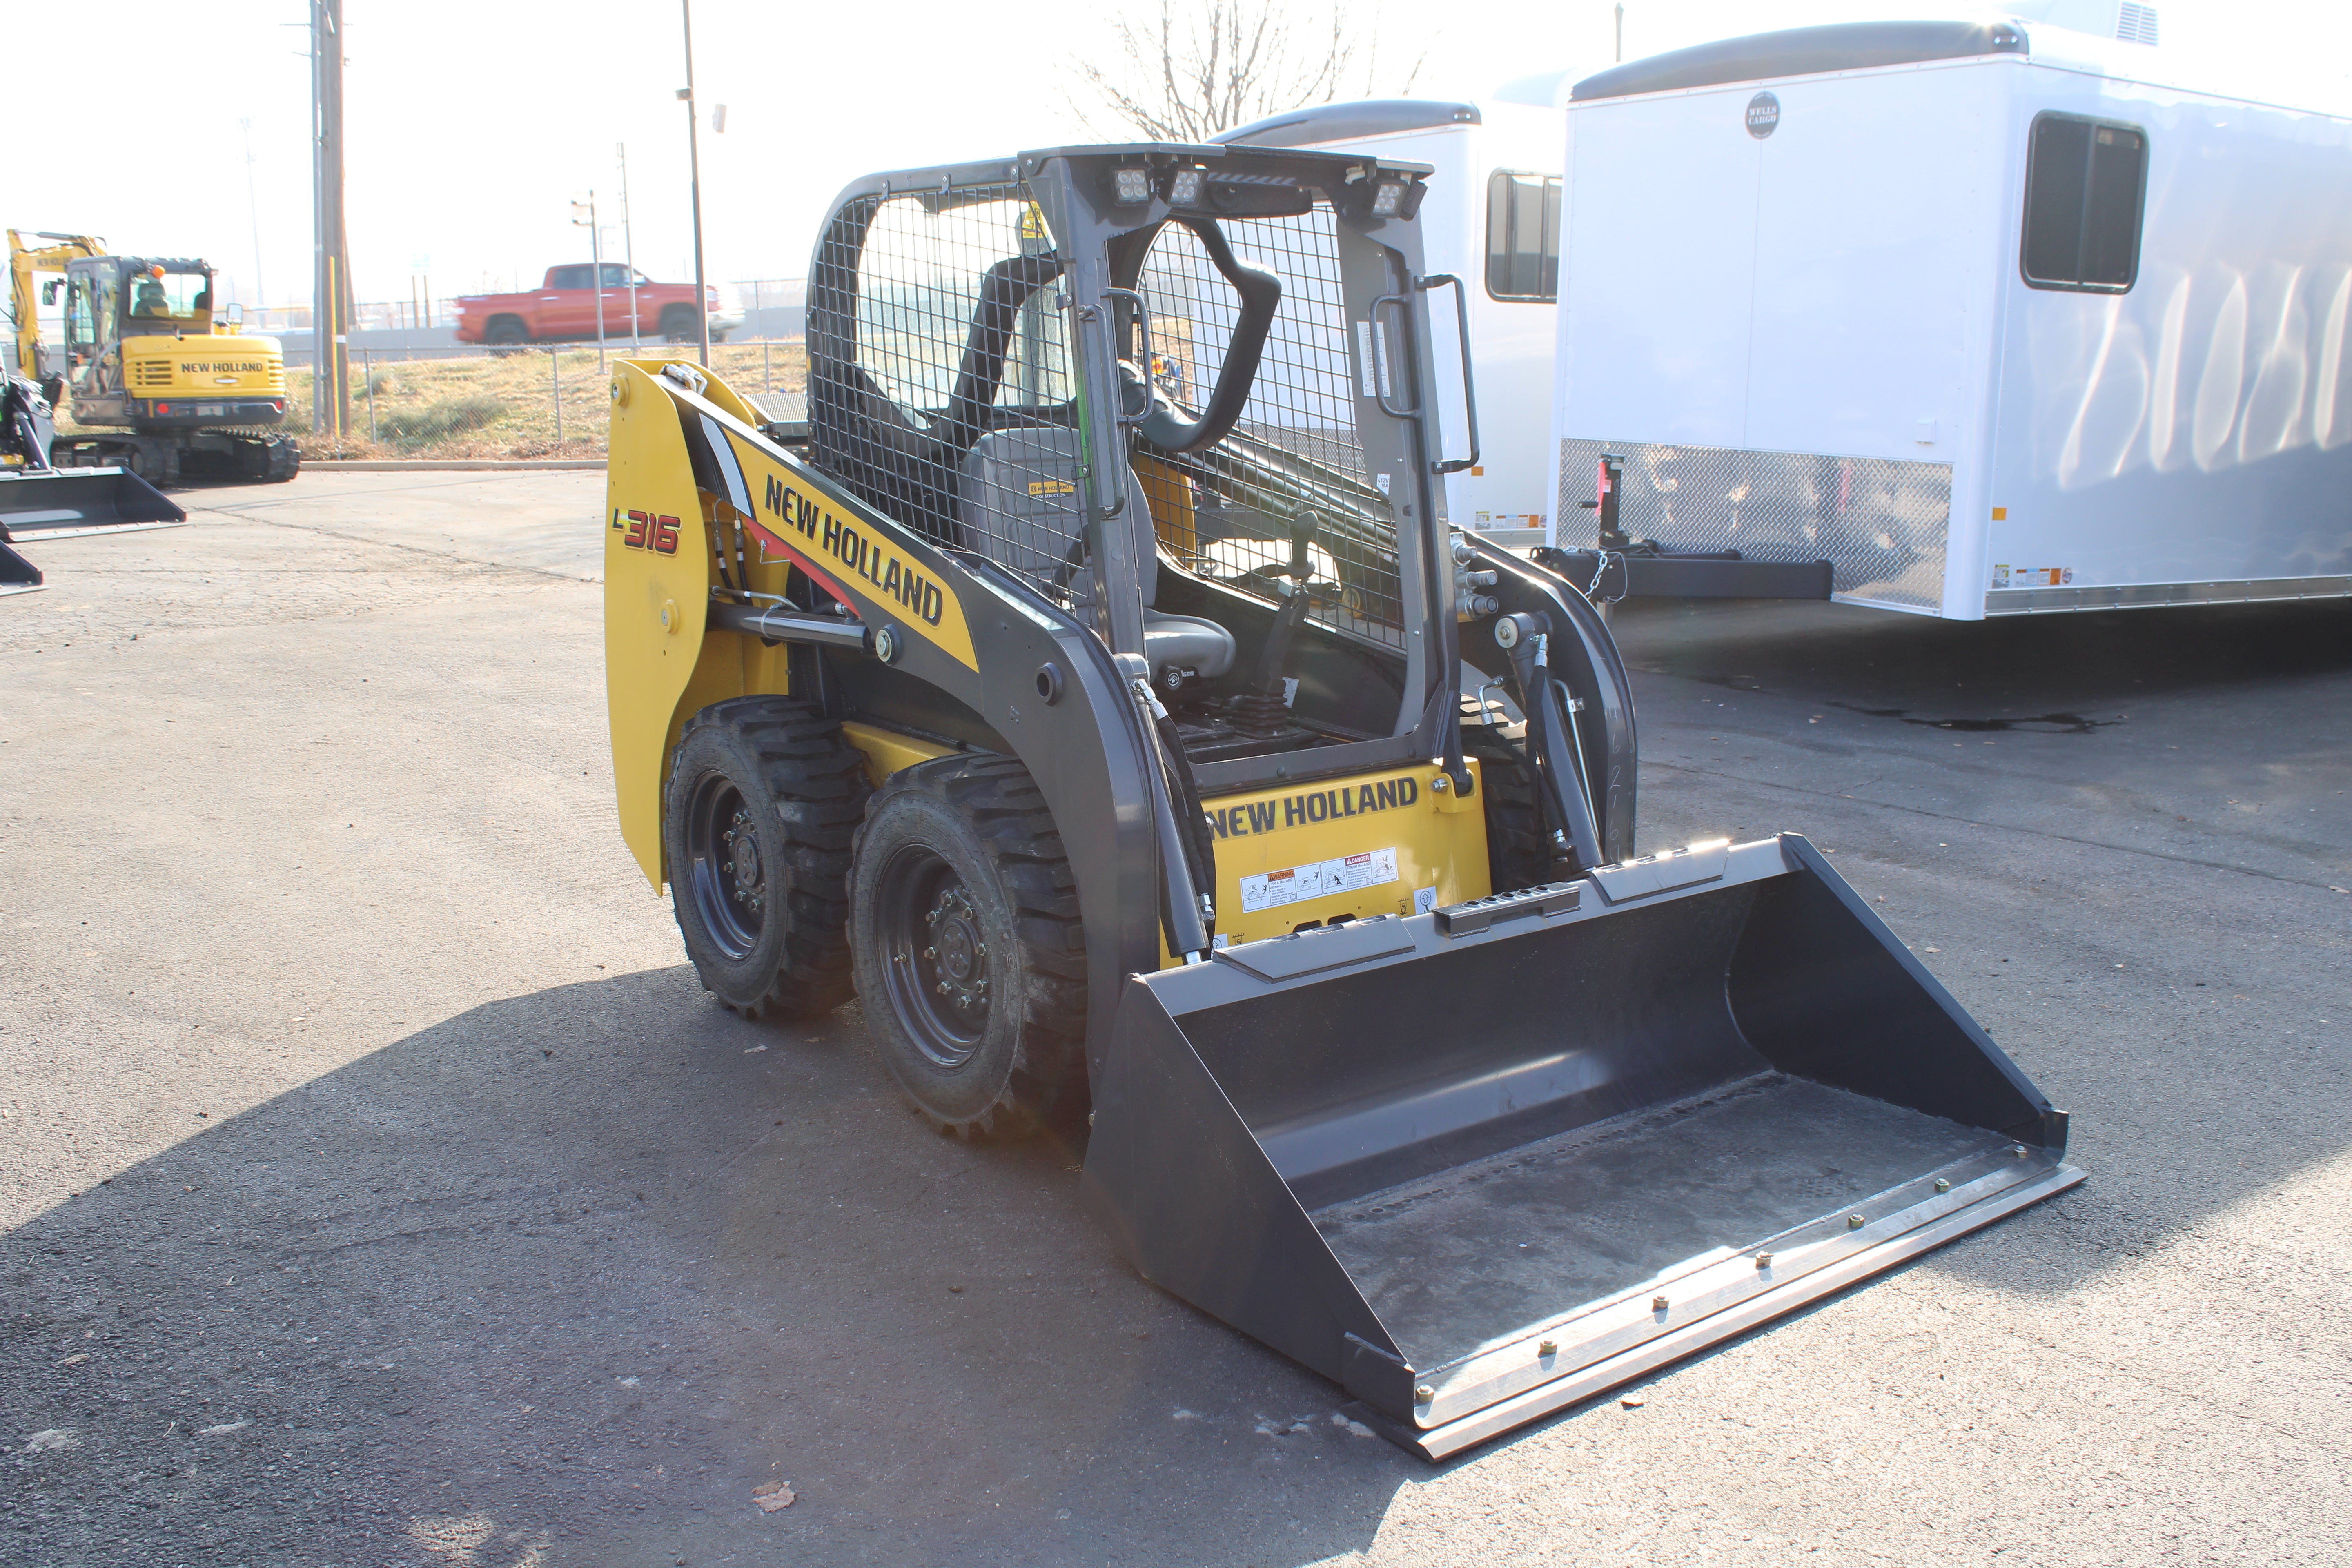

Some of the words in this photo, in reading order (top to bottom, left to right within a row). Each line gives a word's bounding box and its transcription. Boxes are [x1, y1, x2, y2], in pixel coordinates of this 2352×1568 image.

[1749, 106, 1777, 116] WELLS
[1748, 114, 1777, 125] CARGO
[181, 363, 209, 372] NEW
[213, 362, 263, 372] HOLLAND
[612, 508, 681, 555] L316
[765, 473, 820, 541] NEW
[822, 512, 943, 627] HOLLAND
[1205, 800, 1276, 841] NEW
[1284, 777, 1418, 827] HOLLAND
[1351, 855, 1370, 863] DANGER
[1273, 871, 1294, 880] WARNING
